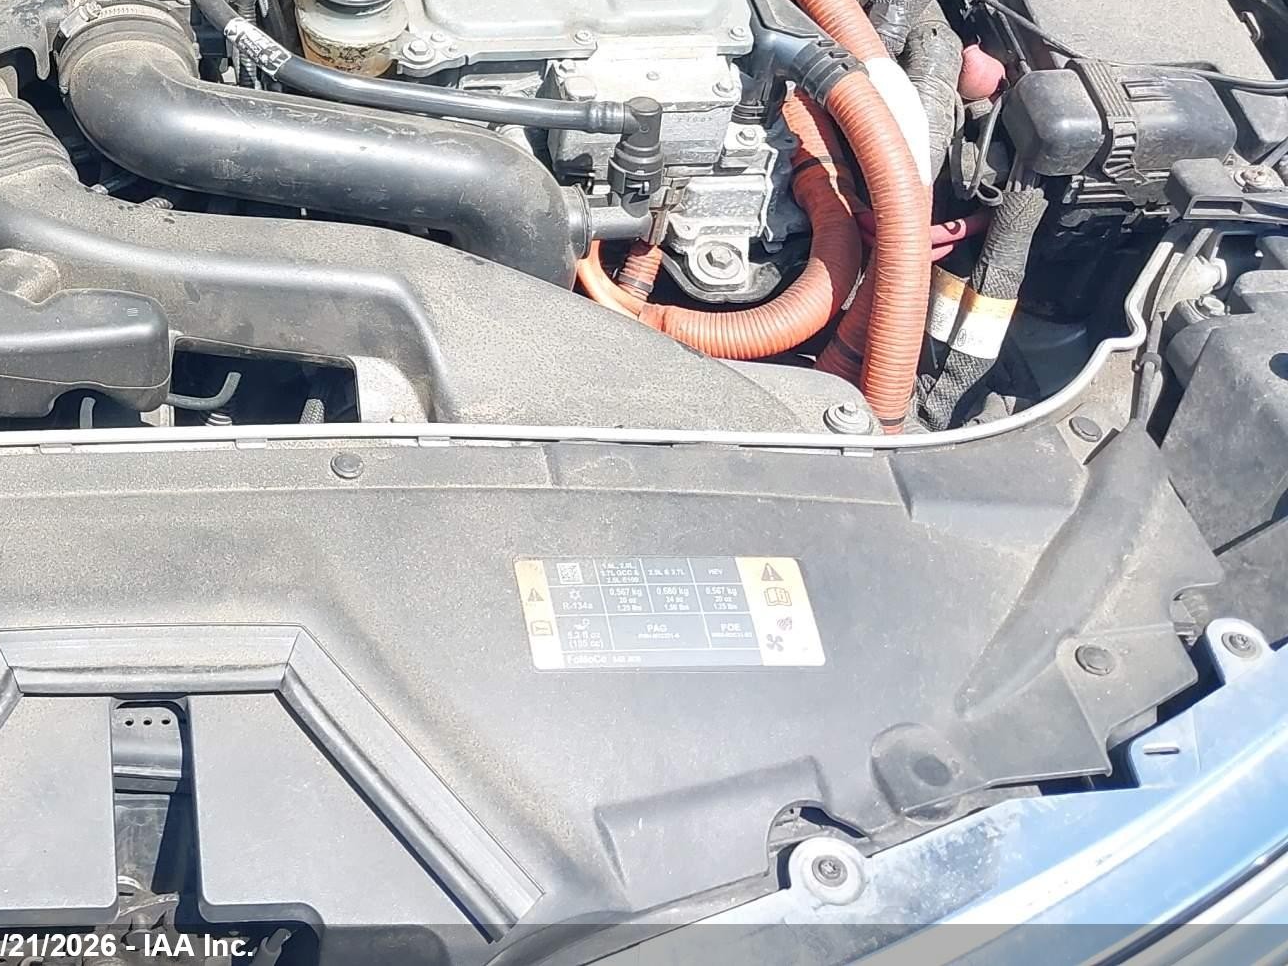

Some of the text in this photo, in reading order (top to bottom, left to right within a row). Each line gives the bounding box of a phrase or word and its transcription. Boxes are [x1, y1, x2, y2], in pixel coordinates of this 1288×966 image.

[631, 587, 643, 597] kg
[678, 586, 689, 596] kg
[727, 586, 738, 596] kg
[562, 602, 593, 611] R-134a
